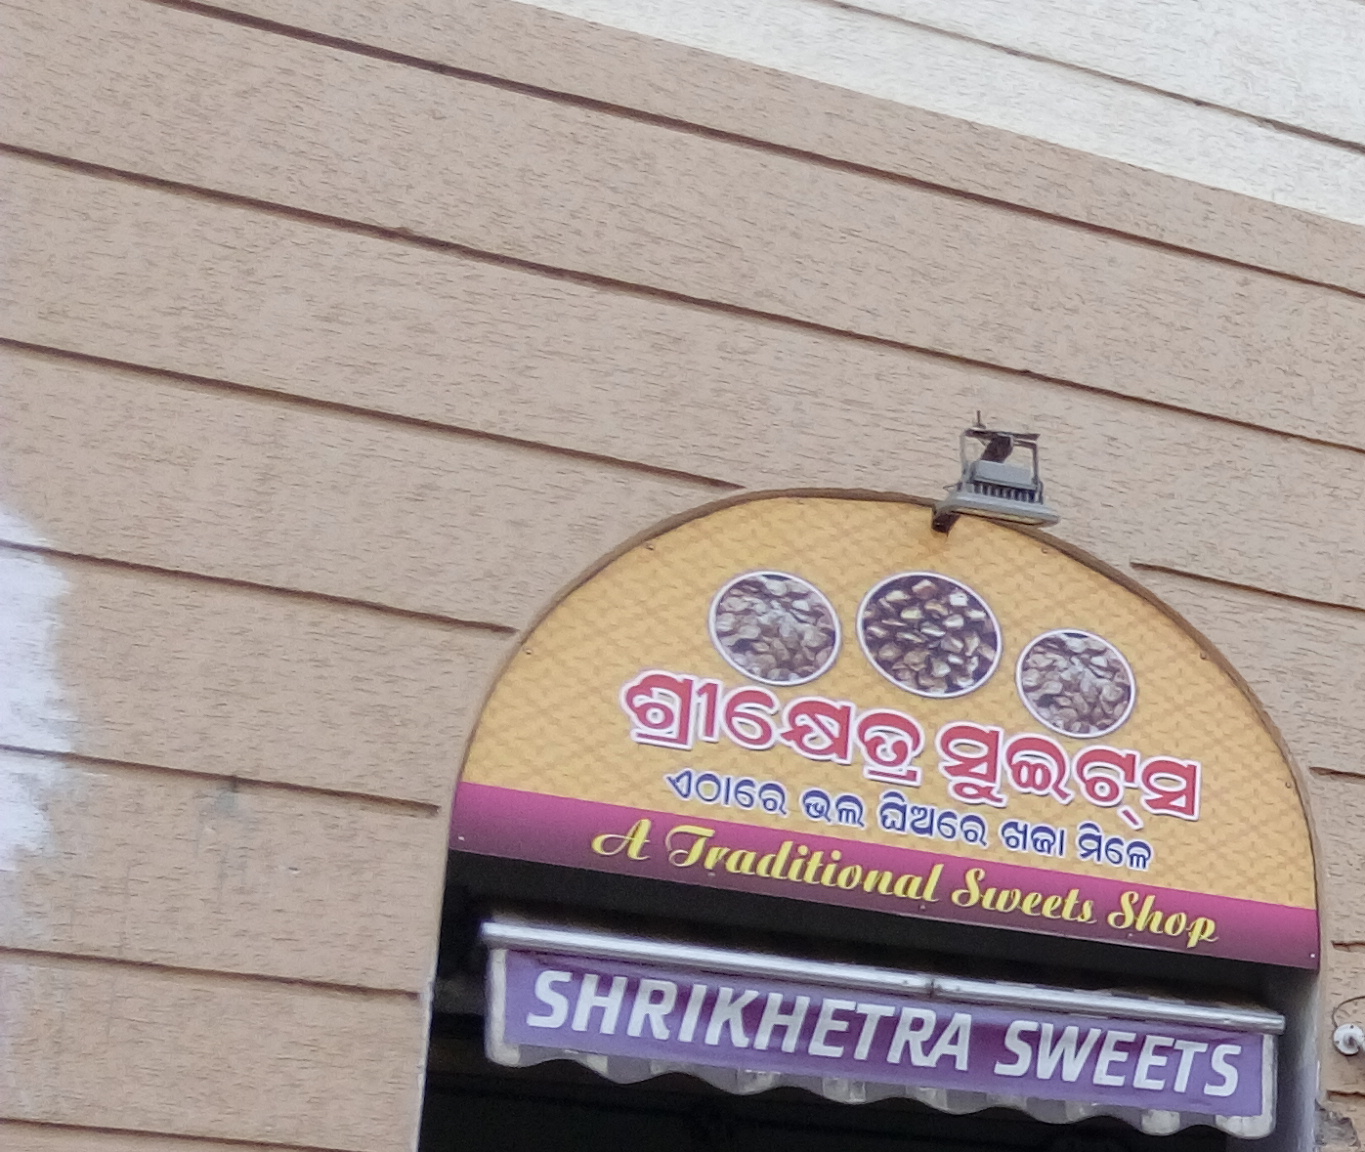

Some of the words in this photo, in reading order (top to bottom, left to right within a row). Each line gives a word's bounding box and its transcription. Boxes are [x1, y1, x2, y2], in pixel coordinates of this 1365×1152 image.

[623, 671, 923, 785] ଶ୍ରୀକ୍ଷେତ୍ର
[666, 769, 786, 815] ଏଠାରେ
[802, 789, 865, 829] ଭଲ
[880, 790, 987, 847] ଘିଅରେ
[1001, 820, 1065, 857] ଖଜା
[1078, 822, 1151, 869] ମିଳେ
[592, 819, 651, 860] A
[665, 825, 944, 902] Traditional
[952, 868, 1097, 924] Sweets
[1107, 891, 1218, 949] Shop
[526, 970, 972, 1071] SHRIKHETRA
[994, 1020, 1241, 1097] SWEETS
